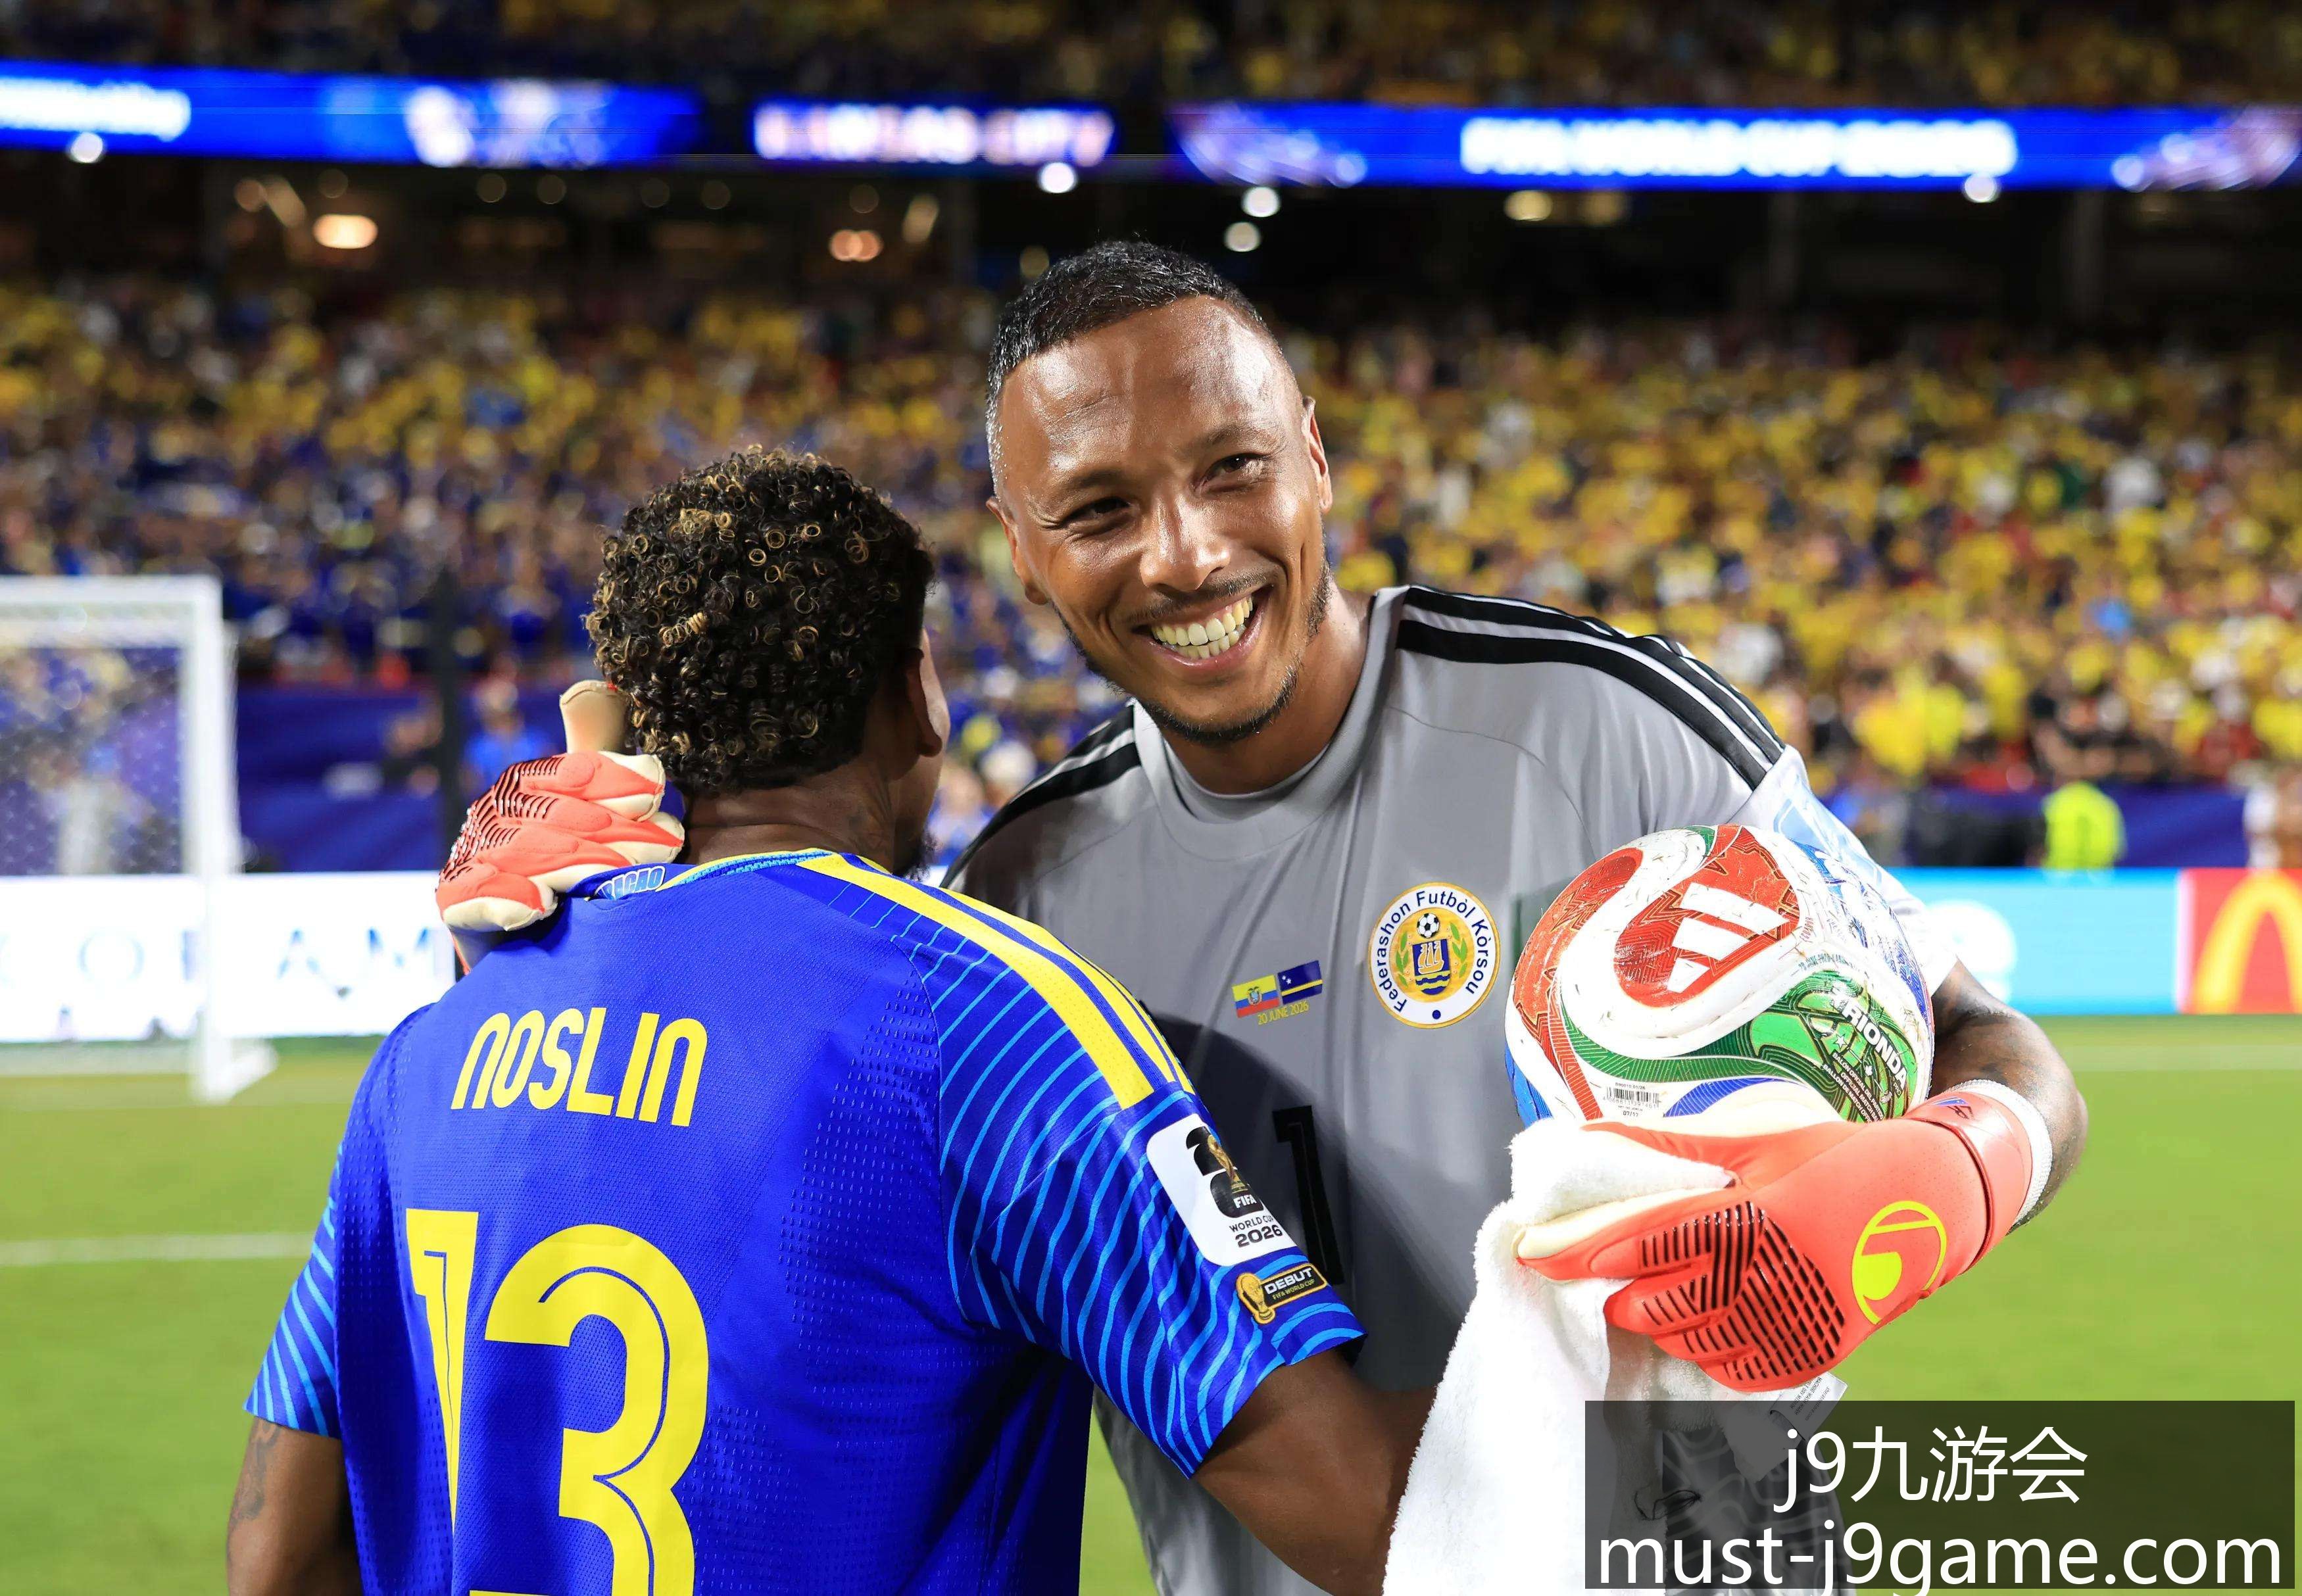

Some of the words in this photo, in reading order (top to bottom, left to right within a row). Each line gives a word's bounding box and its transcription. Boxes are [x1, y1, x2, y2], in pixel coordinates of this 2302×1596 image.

[1377, 903, 1411, 1012] Federashon
[1258, 1013, 1268, 1025] 20
[1269, 1006, 1290, 1022] JUNE
[1289, 1000, 1310, 1016] 2026
[451, 1007, 708, 1127] NOSLIN
[1823, 1064, 1844, 1087] BALLON
[1842, 1084, 1850, 1094] DE
[1848, 1092, 1863, 1113] MATCH
[1861, 1110, 1873, 1123] OFFIC
[1841, 1072, 1861, 1096] OFFICIAL
[1859, 1094, 1873, 1115] MATCH
[1893, 1082, 1901, 1096] PRO
[1871, 1098, 1884, 1120] PARTIDO
[1233, 1194, 1257, 1209] FIFA
[1229, 1217, 1262, 1232] WORLD
[1235, 1224, 1283, 1247] 2026
[1264, 1268, 1311, 1294] DEBUT
[1272, 1291, 1286, 1300] FIFA
[1285, 1283, 1305, 1295] WORLD
[1305, 1278, 1315, 1287] CUP
[405, 1208, 710, 1596] 13
